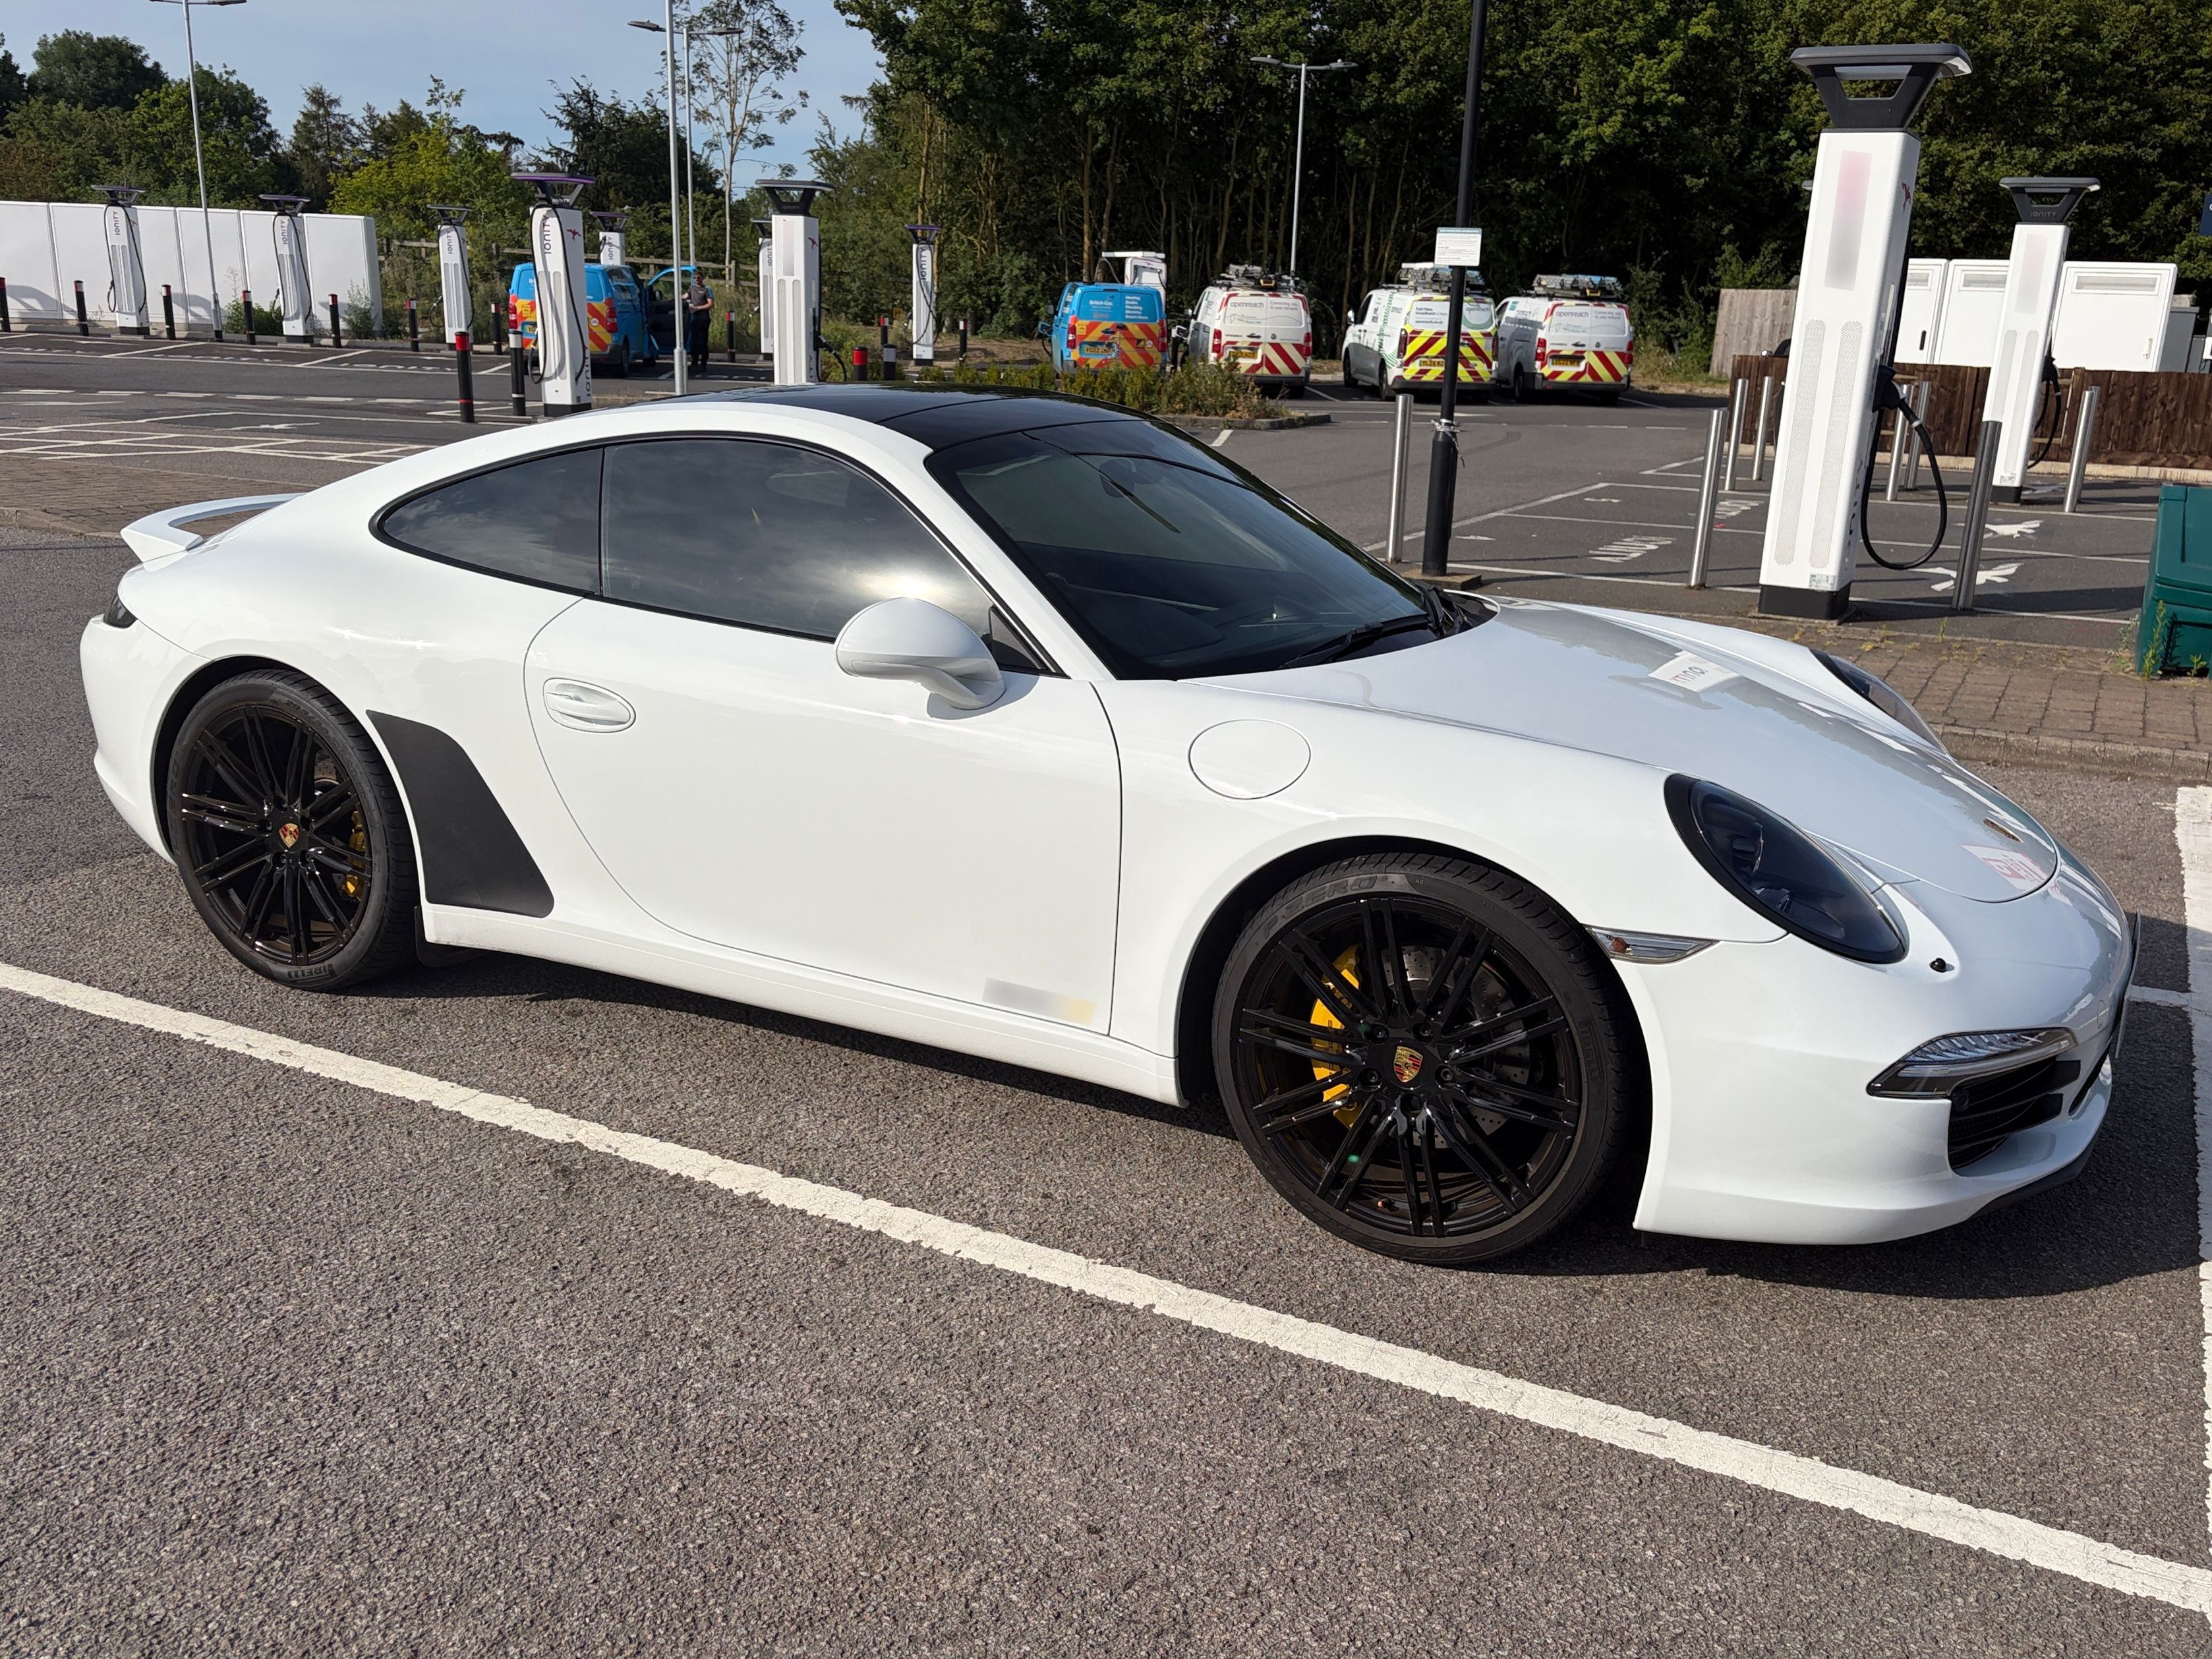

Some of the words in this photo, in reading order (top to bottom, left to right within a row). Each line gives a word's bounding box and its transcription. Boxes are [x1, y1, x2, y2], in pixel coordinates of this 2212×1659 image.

[279, 219, 288, 245] IONITY
[542, 214, 552, 254] IONITY
[1281, 875, 1378, 920] ZERO
[288, 963, 337, 983] PIRELLI
[1578, 1019, 1605, 1082] PIRELLI
